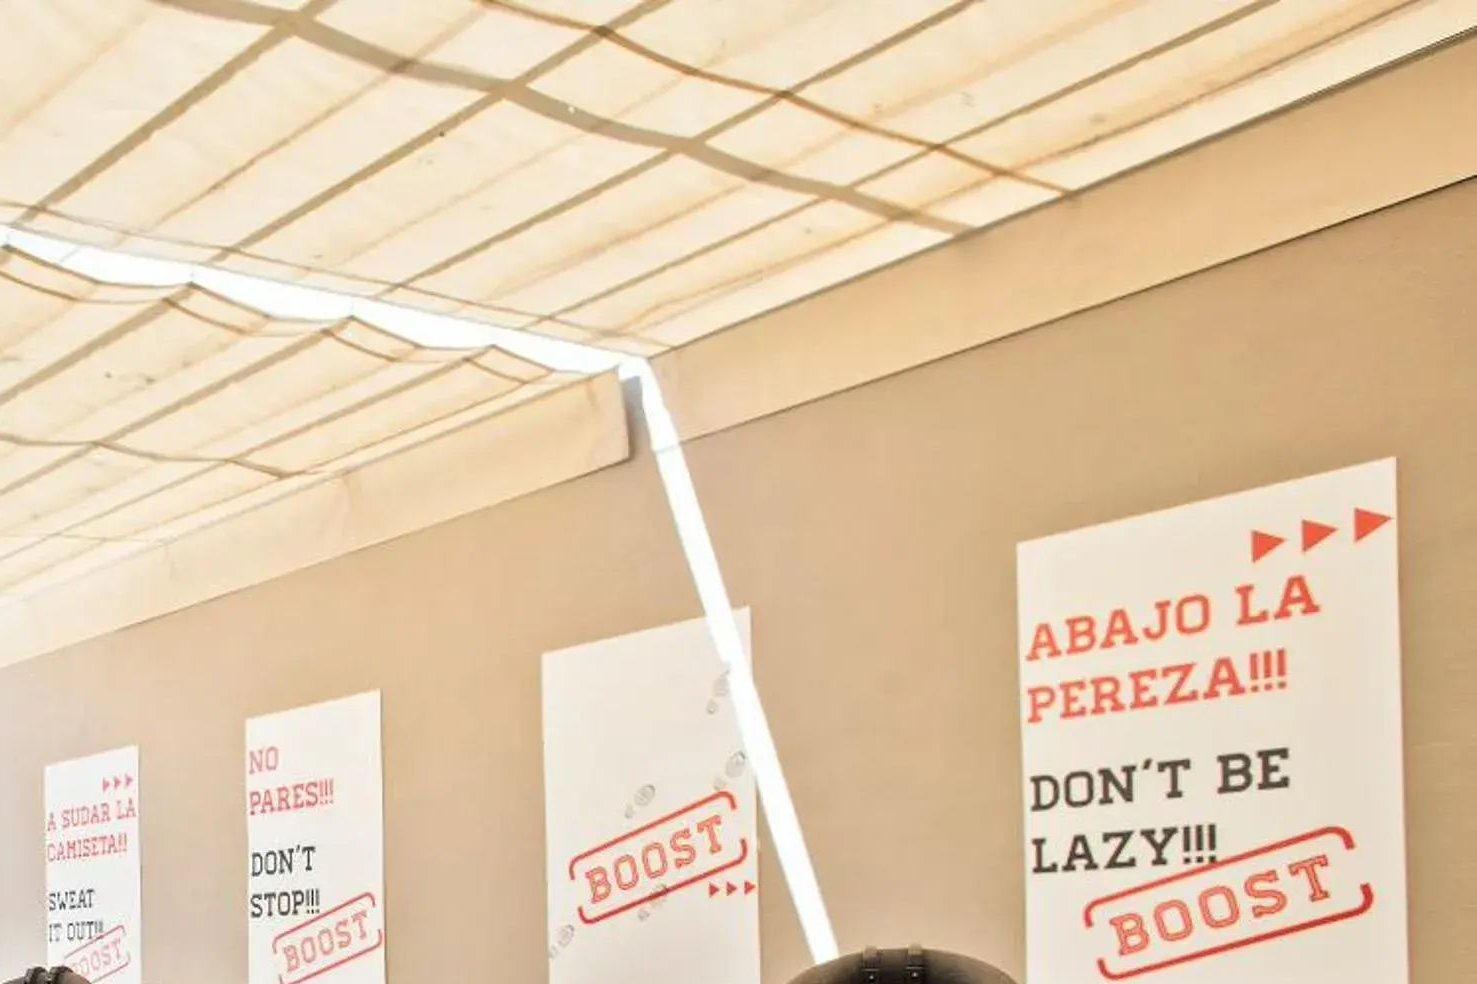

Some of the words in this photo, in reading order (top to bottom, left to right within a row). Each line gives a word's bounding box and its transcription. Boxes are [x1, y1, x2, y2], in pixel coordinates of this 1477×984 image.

[1026, 594, 1211, 661] ABAJO
[1236, 574, 1321, 627] LA
[1027, 649, 1289, 724] PEREZA!!!
[249, 746, 279, 775] NO
[1030, 758, 1192, 812] DON'T
[1217, 748, 1291, 795] BE
[47, 813, 57, 832] A
[61, 803, 111, 829] SUDAR
[116, 798, 137, 820] LA
[249, 778, 334, 815] PARES!!!
[251, 846, 316, 877] DON'T
[585, 815, 723, 904] BOOST
[1032, 824, 1218, 874] LAZY!!!
[49, 889, 95, 911] SWEAT
[250, 889, 321, 919] STOP!!!
[1109, 855, 1330, 956] BOOST
[49, 922, 62, 943] IT
[283, 911, 369, 973] BOOST
